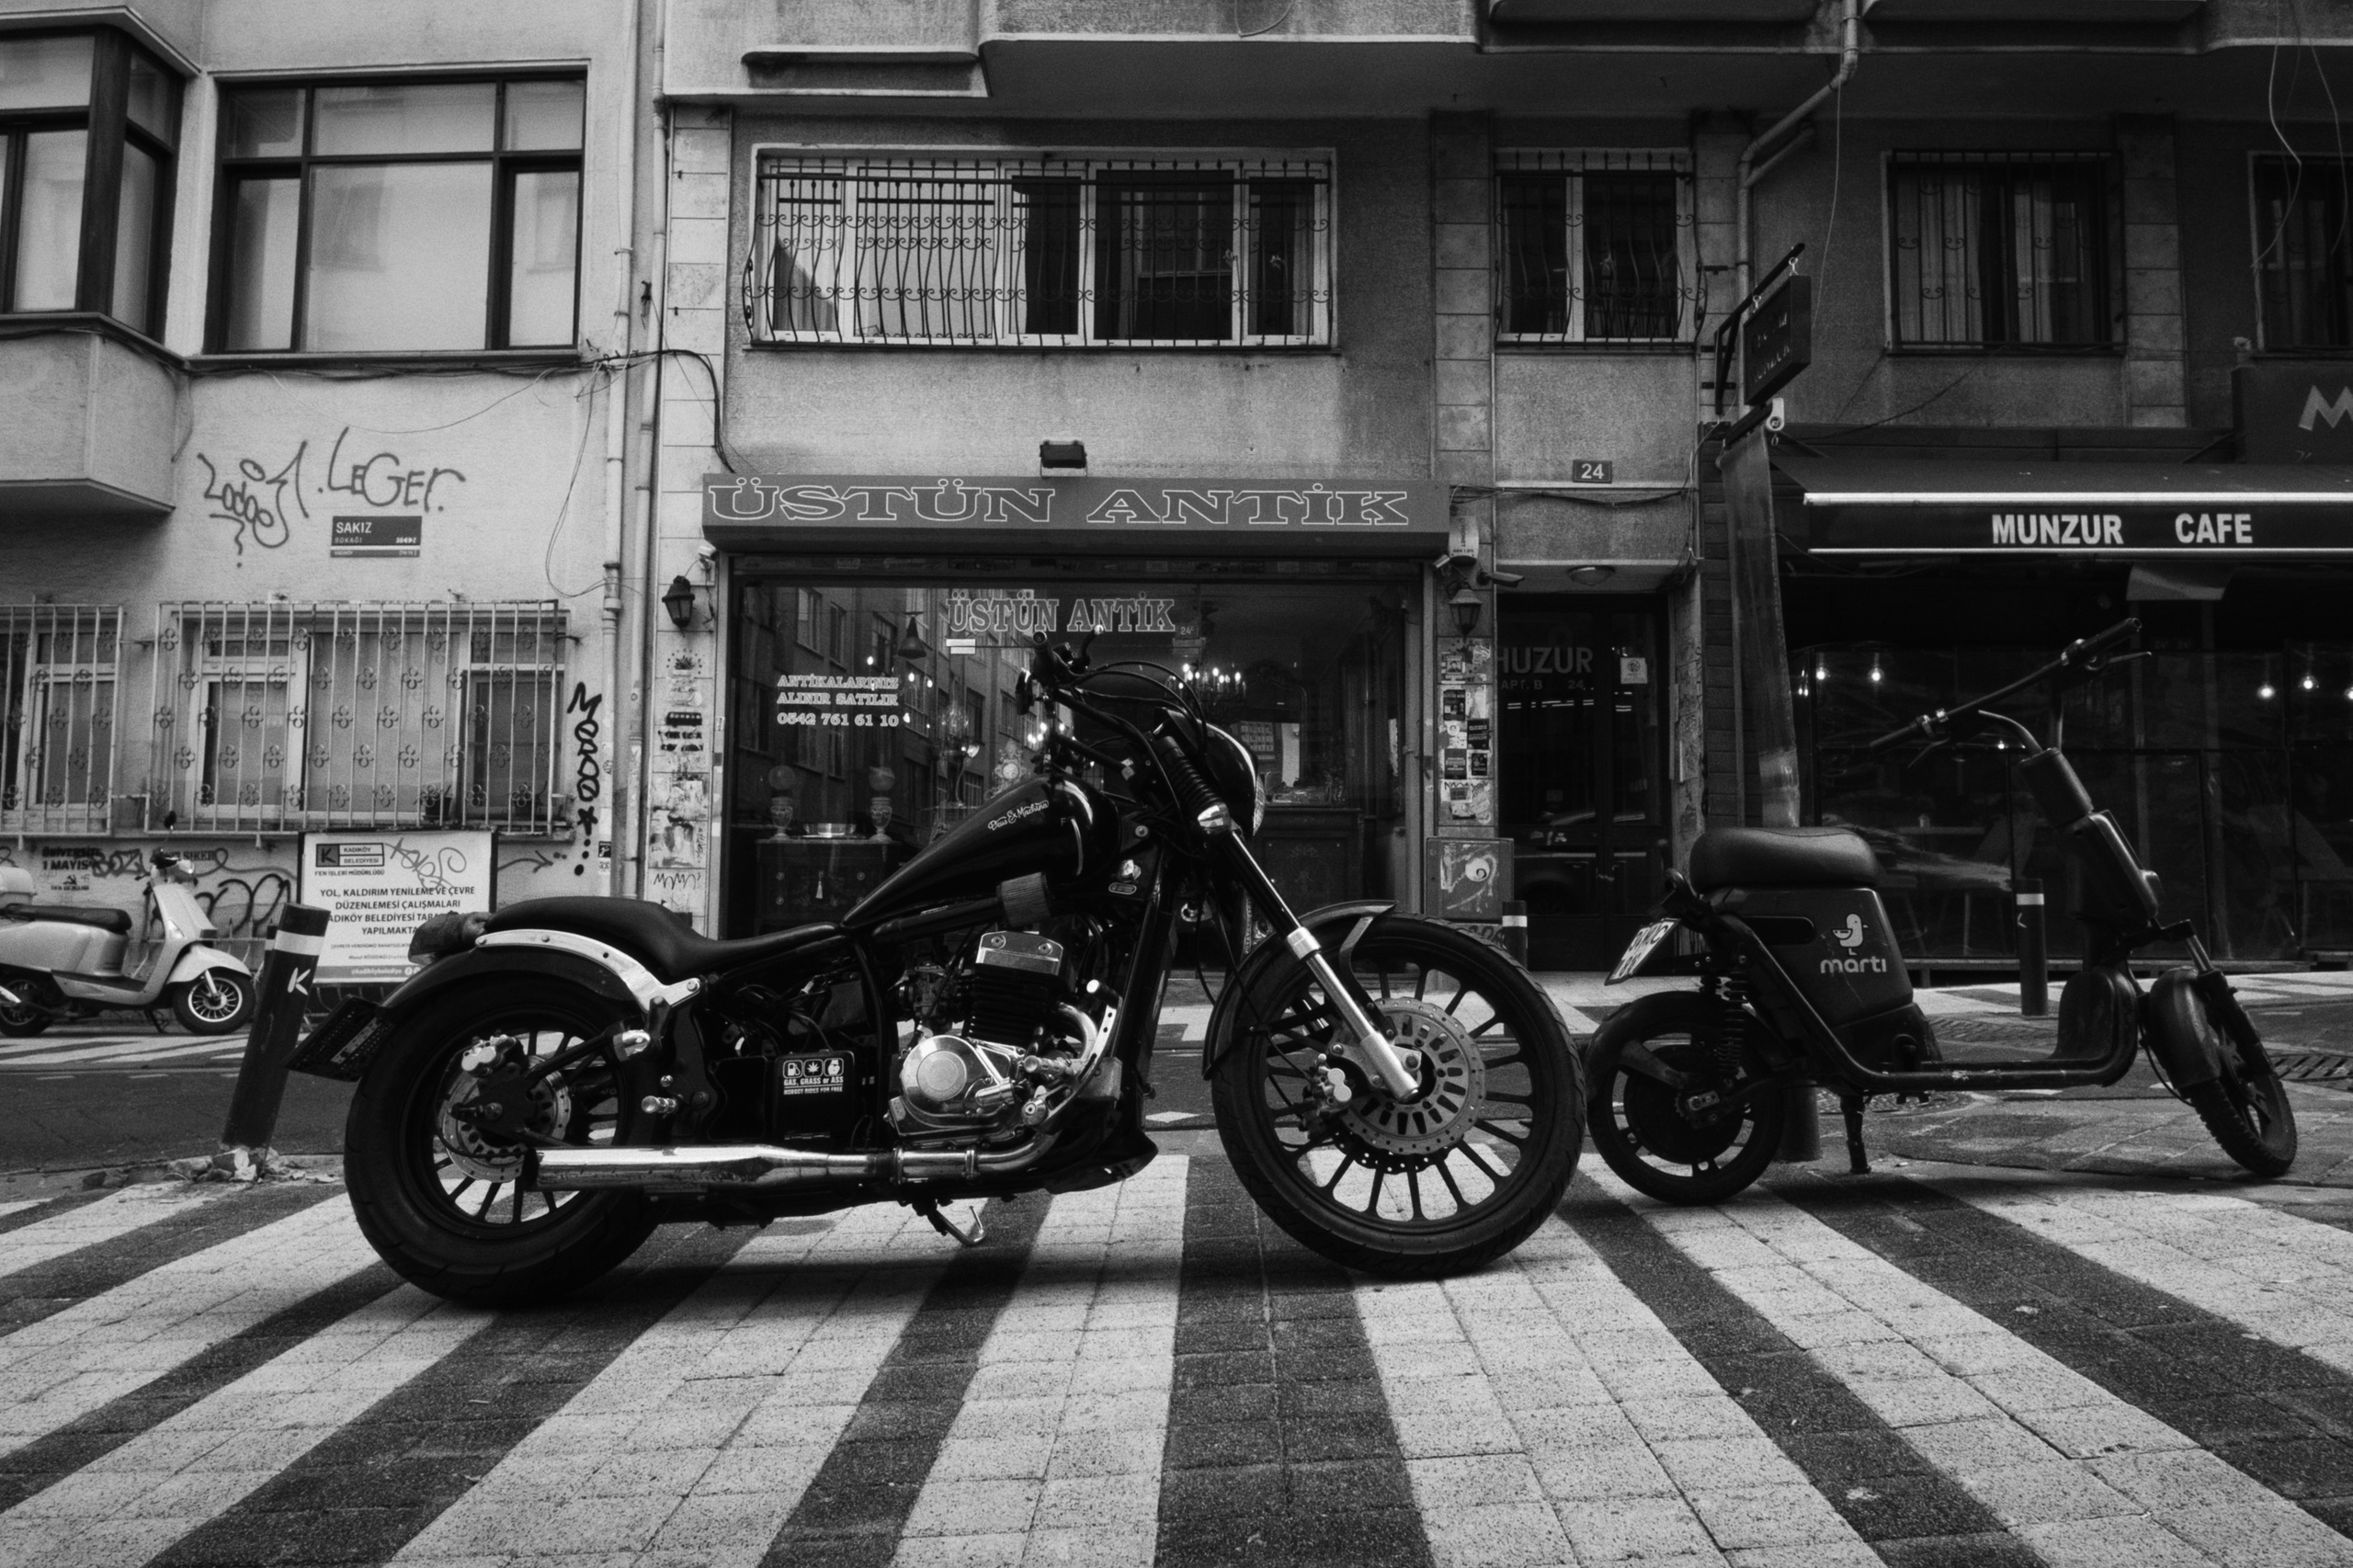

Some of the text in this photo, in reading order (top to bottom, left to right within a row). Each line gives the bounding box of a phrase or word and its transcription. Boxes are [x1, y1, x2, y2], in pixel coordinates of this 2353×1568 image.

[1581, 462, 1605, 480] 24
[708, 477, 1410, 526] ÜSTÜN ANTİK
[335, 521, 372, 534] SAKIZ
[1992, 512, 2253, 545] MUNZUR CAFE
[335, 536, 363, 544] SOKAĞI
[946, 590, 1176, 632] ÜSTÜN ANTİK
[777, 673, 899, 689] ANTİKALARINIZ
[777, 691, 899, 706] ALINIR SATILIR
[777, 712, 900, 727] 0542 761 61 10
[321, 886, 475, 898] YOL, KALDIRIM YENİLEME VE ÇEVRE
[335, 900, 460, 910] DÜZENLEMESİ ÇALIŞMALARI
[327, 913, 363, 923] ADIKÖY
[365, 912, 415, 922] BELEDİYESİ
[362, 926, 418, 935] YAPILMAKTA
